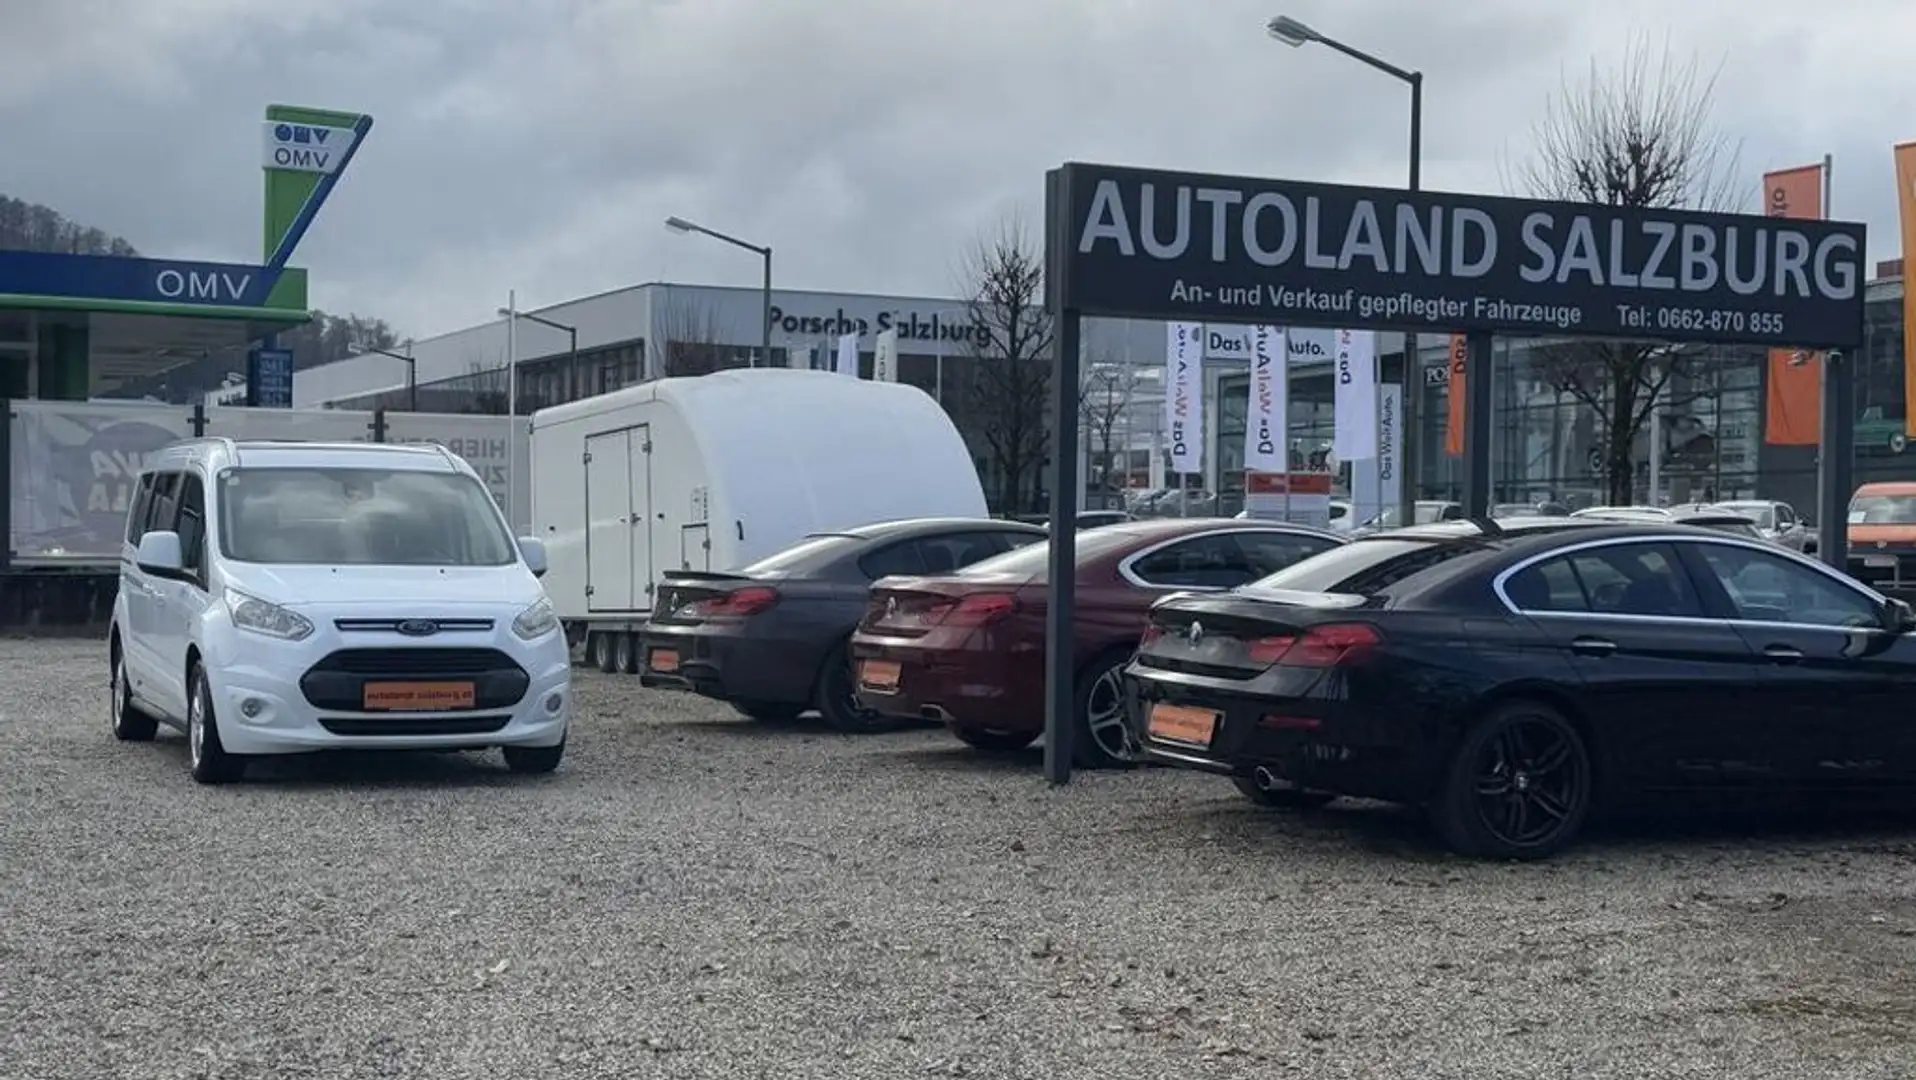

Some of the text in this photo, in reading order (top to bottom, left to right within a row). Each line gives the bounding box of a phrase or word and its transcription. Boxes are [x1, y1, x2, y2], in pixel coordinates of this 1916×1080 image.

[274, 148, 330, 168] OMV
[1078, 179, 1857, 300] AUTOLAND SALZBURG
[156, 269, 250, 300] OMV
[1170, 279, 1784, 334] An- und Verkauf gepflegter Fahrzeuge Tel: 0662-870 855
[769, 306, 991, 348] Porsche Salzburg
[1210, 332, 1241, 351] Das
